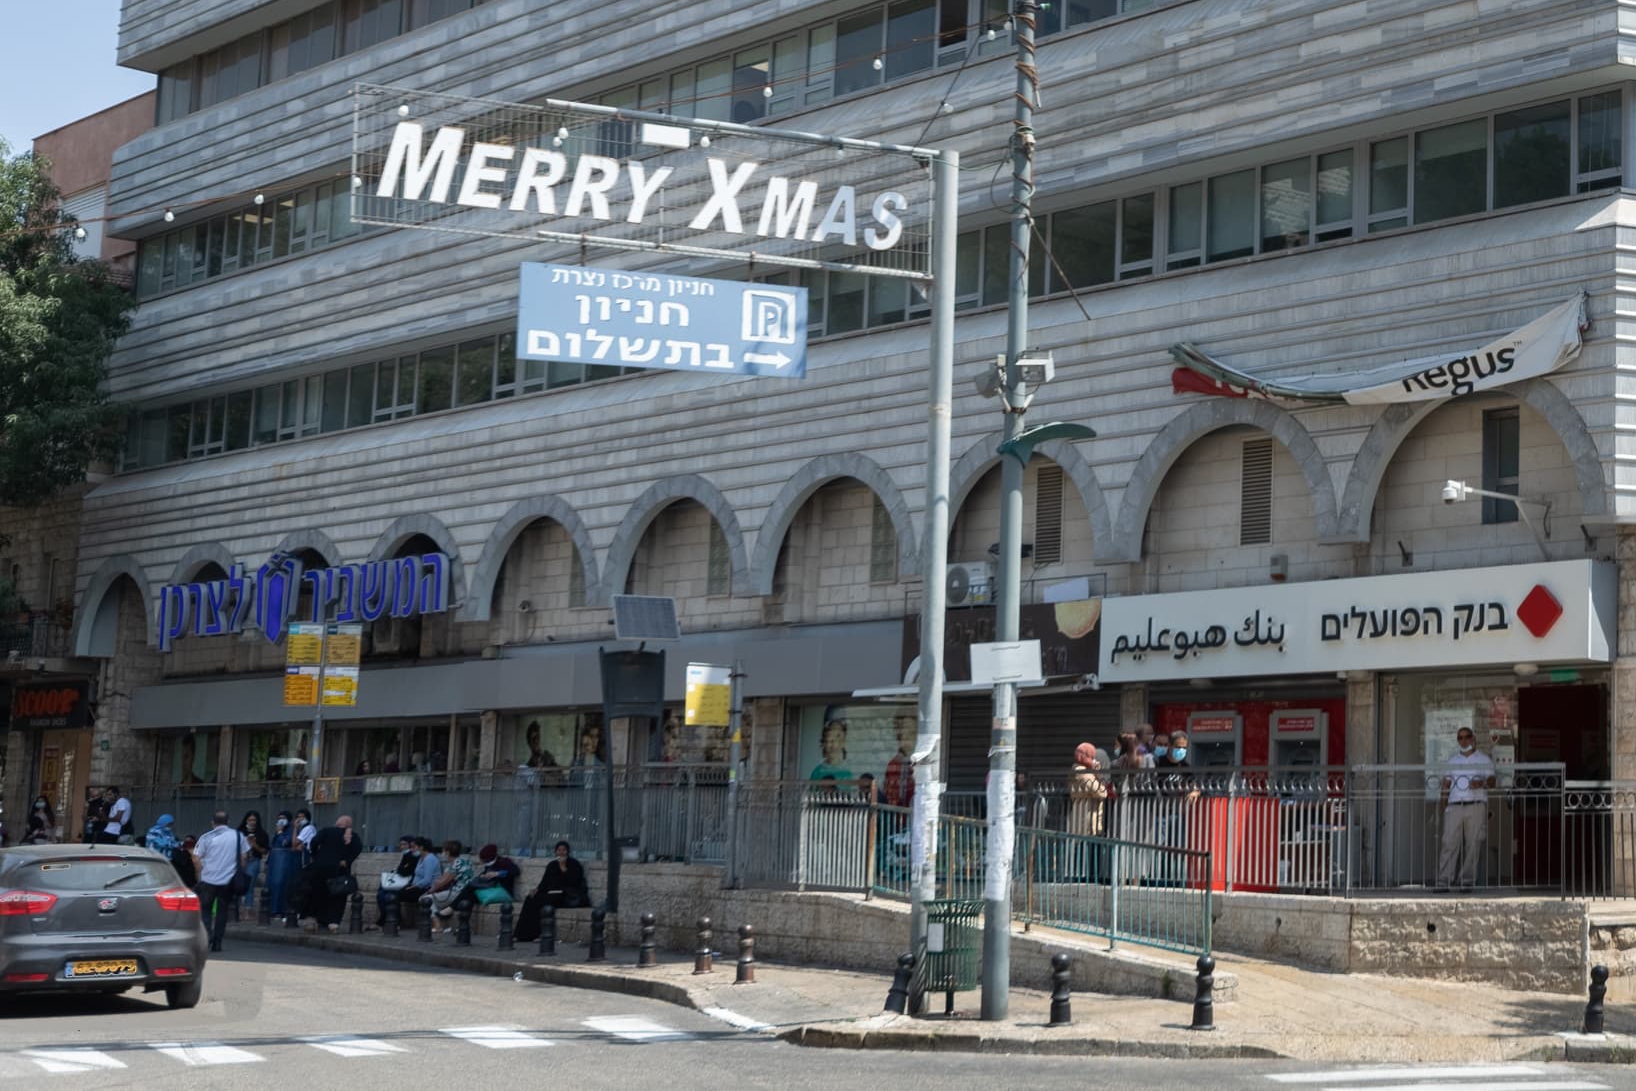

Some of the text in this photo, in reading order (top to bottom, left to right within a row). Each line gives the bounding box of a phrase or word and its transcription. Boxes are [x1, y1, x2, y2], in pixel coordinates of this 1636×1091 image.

[376, 122, 674, 224] MERRY
[552, 268, 714, 297] חניון מרכז נצרת
[575, 294, 690, 327] חניון
[527, 328, 735, 369] בתשלום
[159, 562, 252, 653] לצרכן
[304, 552, 450, 624] המשביר
[1111, 616, 1227, 664] هبوعليم
[1233, 609, 1287, 653] بنك
[1320, 601, 1508, 642] בנק הפועלים
